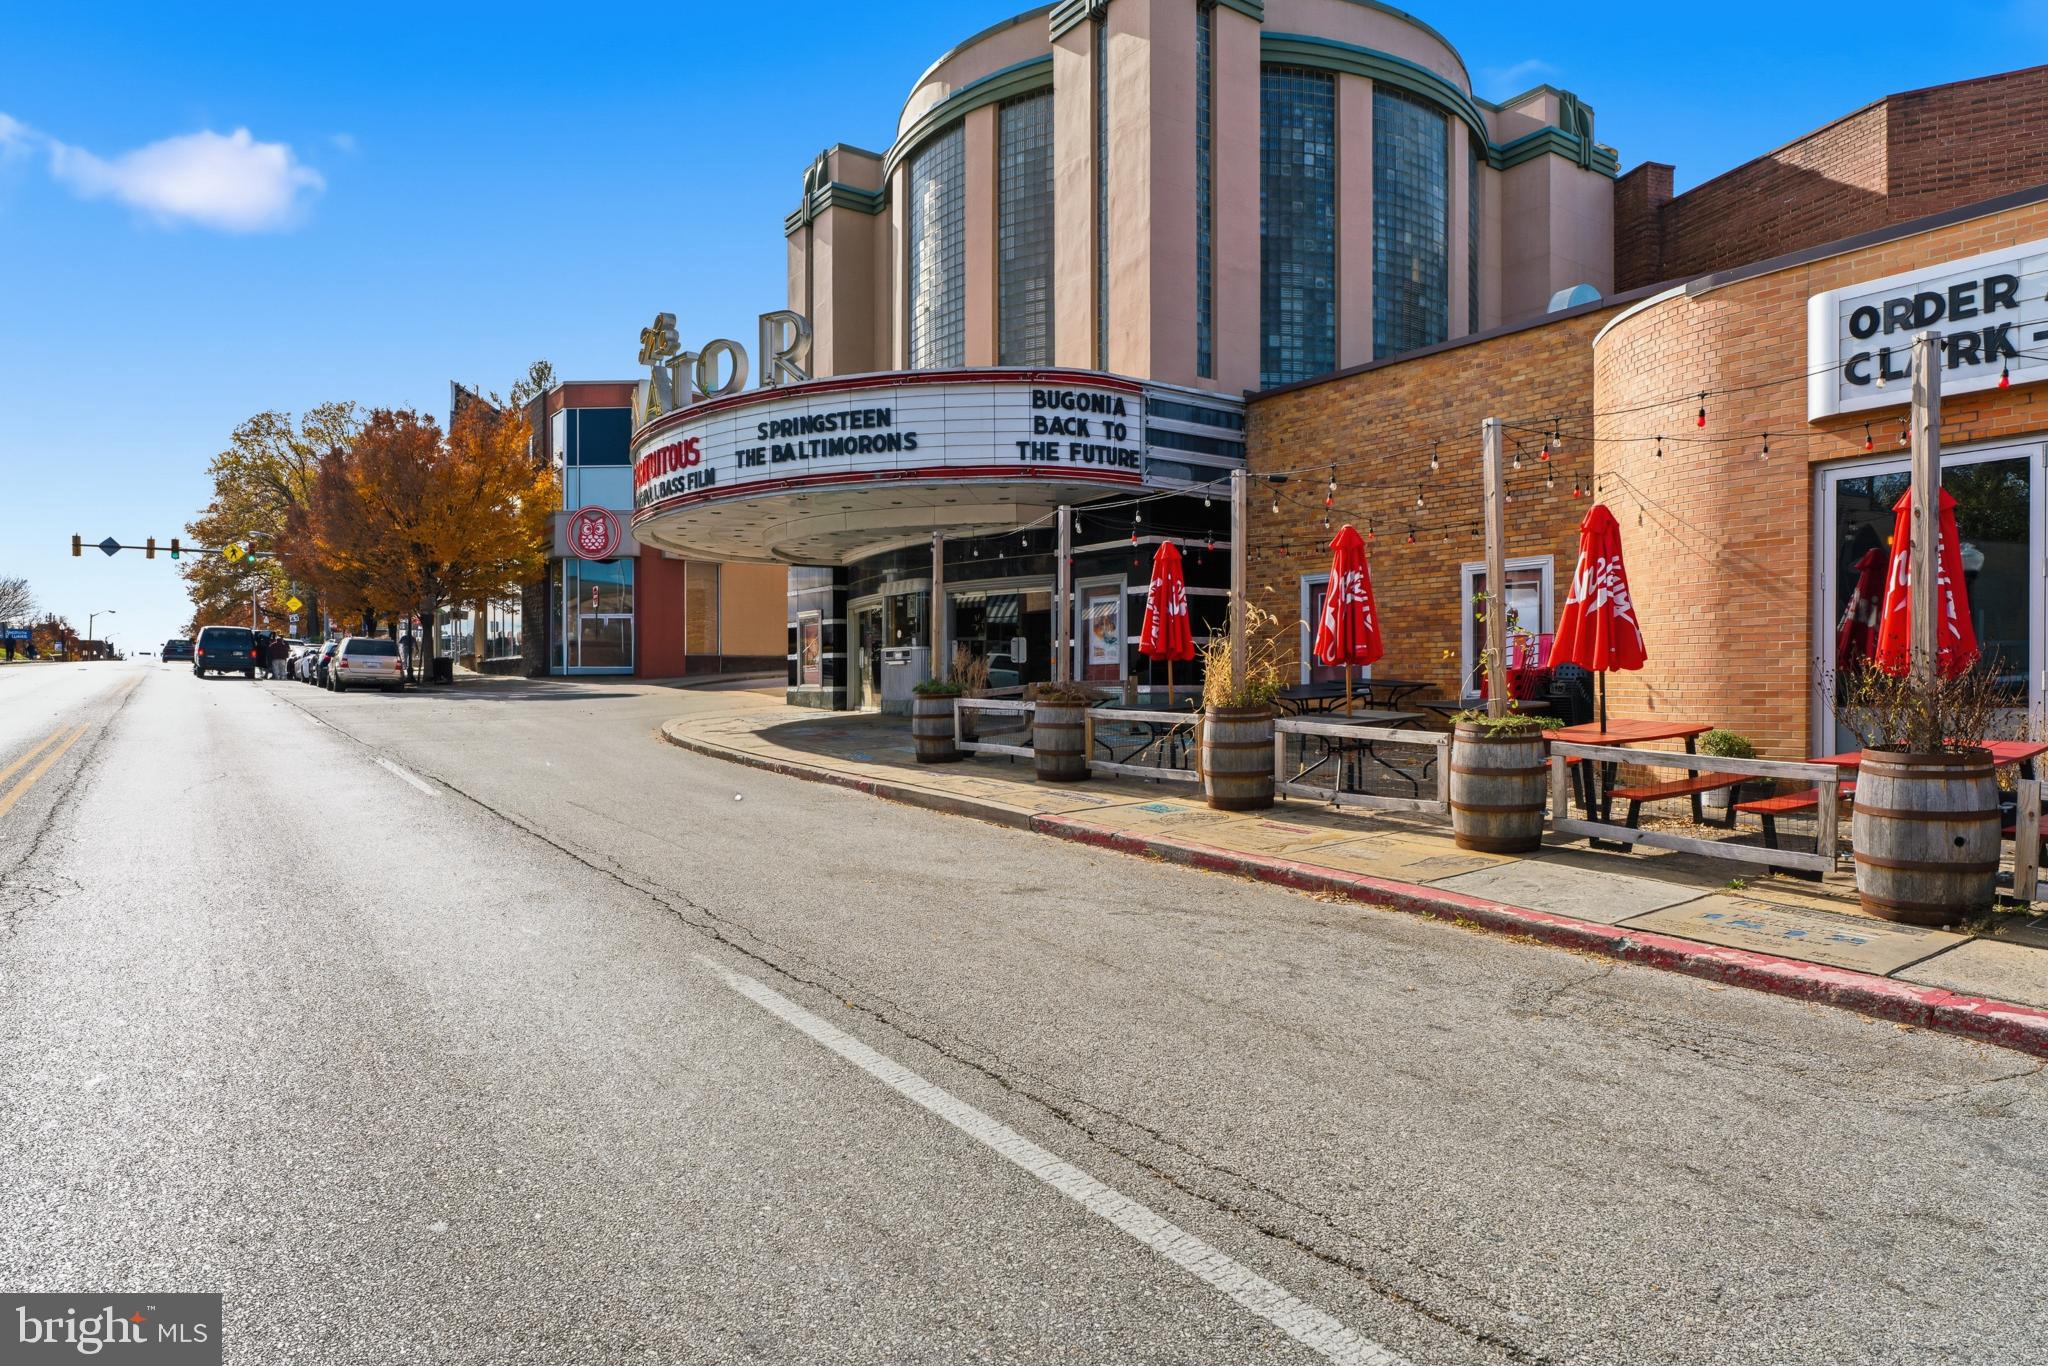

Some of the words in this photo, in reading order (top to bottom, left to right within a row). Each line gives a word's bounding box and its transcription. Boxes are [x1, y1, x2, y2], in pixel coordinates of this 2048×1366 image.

[1849, 273, 2020, 340] ORDER
[1844, 322, 2018, 386] CLRK
[1032, 389, 1126, 417] BUGONIA
[757, 408, 891, 441] SPRINGSTEEN
[1033, 415, 1090, 438] BACK
[1102, 420, 1127, 441] TO
[635, 437, 701, 489] RATUITOUS
[735, 446, 767, 469] THE
[771, 431, 918, 464] BALTIMORONS
[1016, 441, 1060, 461] THE
[1069, 442, 1140, 469] FUTURE
[660, 475, 685, 499] BASS
[687, 467, 715, 491] FILM
